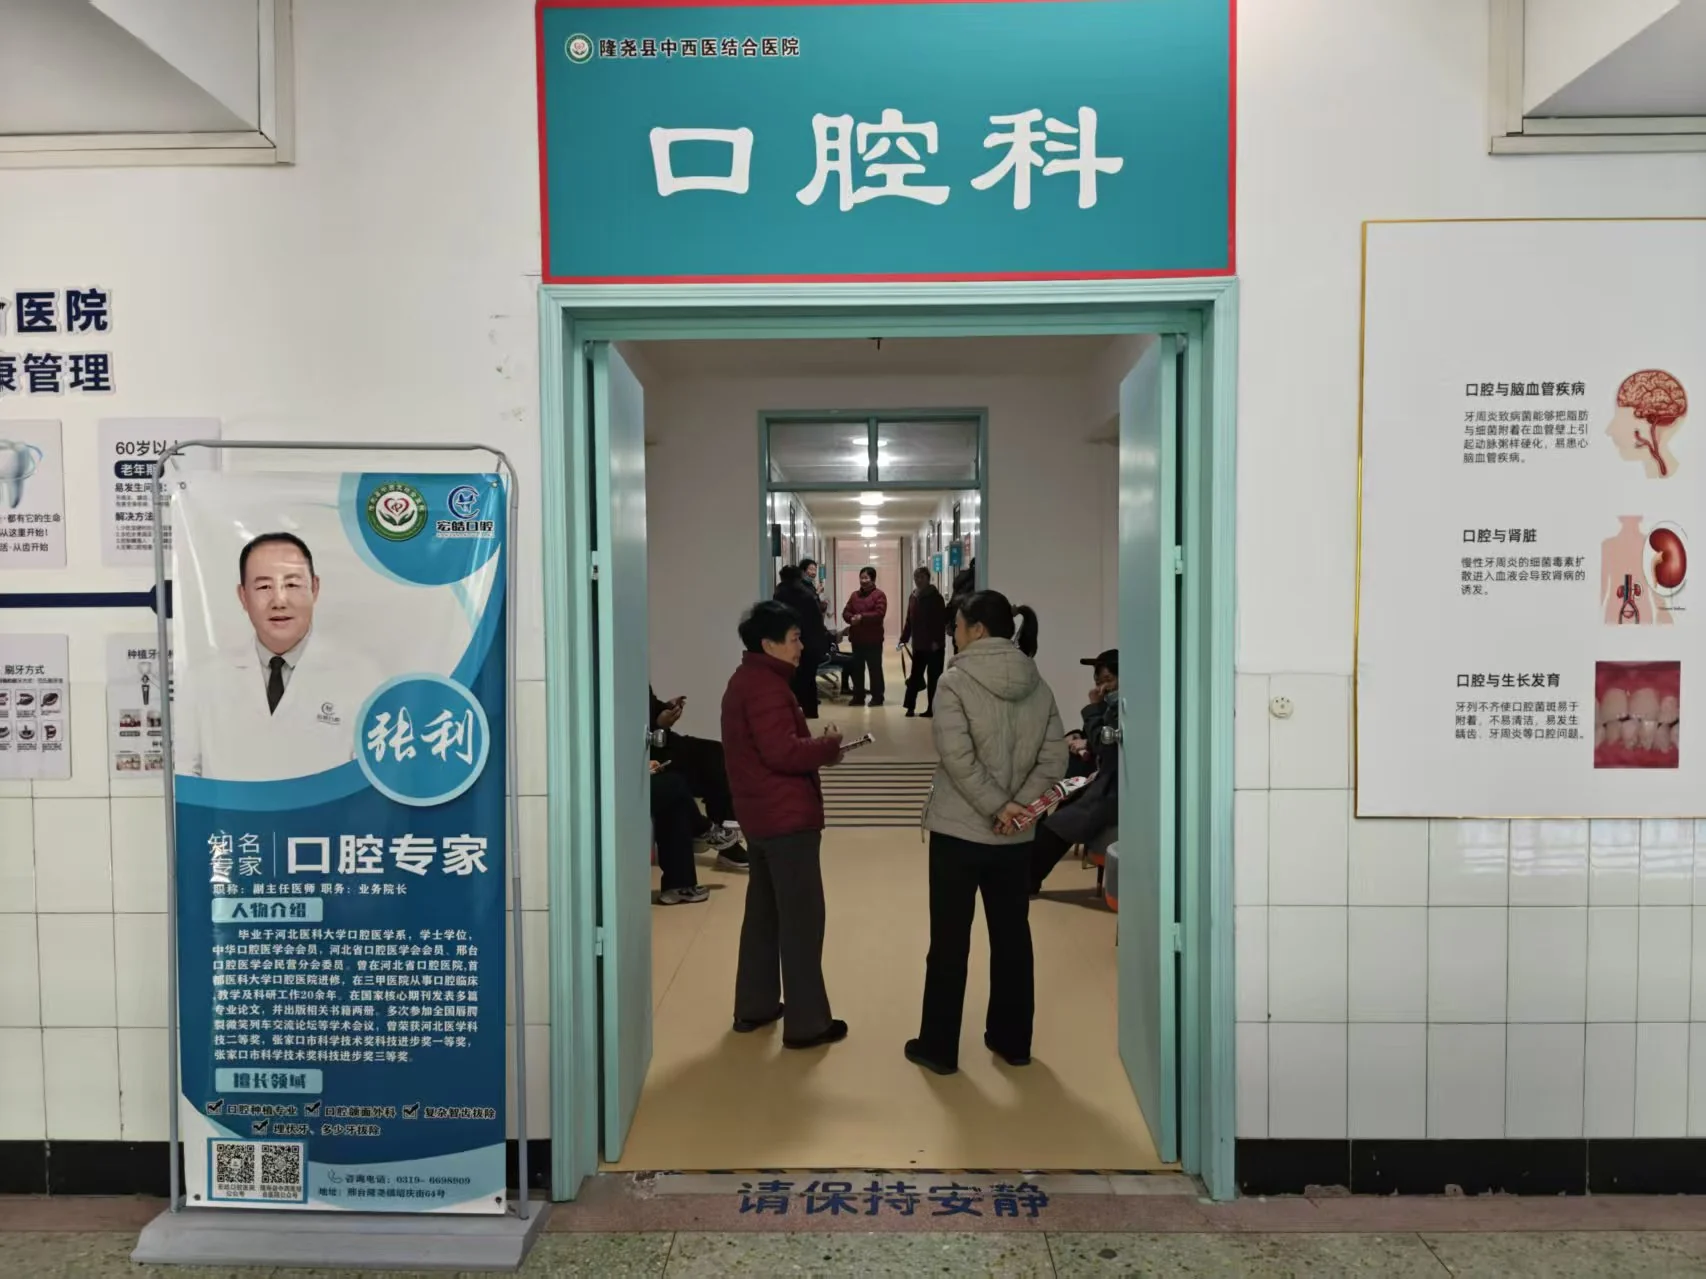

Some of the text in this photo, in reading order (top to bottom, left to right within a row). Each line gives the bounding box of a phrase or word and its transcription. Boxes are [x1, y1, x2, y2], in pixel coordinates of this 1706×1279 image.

[599, 37, 800, 58] 隆尧县中西医结合医院
[648, 106, 1124, 212] 口腔科
[0, 288, 108, 333] 医院
[1465, 381, 1586, 397] 口腔与脑血管疾病
[1464, 410, 1589, 422] 牙周炎致病菌能够把脂肪
[1463, 424, 1588, 436] 与细菌附着在血管壁上引
[1463, 452, 1526, 464] 脑血管疾病。
[1462, 528, 1538, 544] 口腔与肾脏
[1461, 556, 1586, 569] 慢性牙周炎的细菌毒素扩
[1461, 570, 1586, 582] 散进入血液会导致肾病的
[1461, 585, 1489, 596] 诱发。
[1456, 673, 1560, 688] 口腔与生长发育
[1455, 701, 1579, 713] 牙列不齐使口腔菌斑易于
[367, 706, 474, 766] 张利
[287, 833, 489, 876] 口腔专家
[231, 902, 307, 919] 人物介绍
[233, 1072, 307, 1090] 擅长领域
[226, 1103, 299, 1117] 口腔种植专业
[737, 1180, 1049, 1218] 请保持安静
